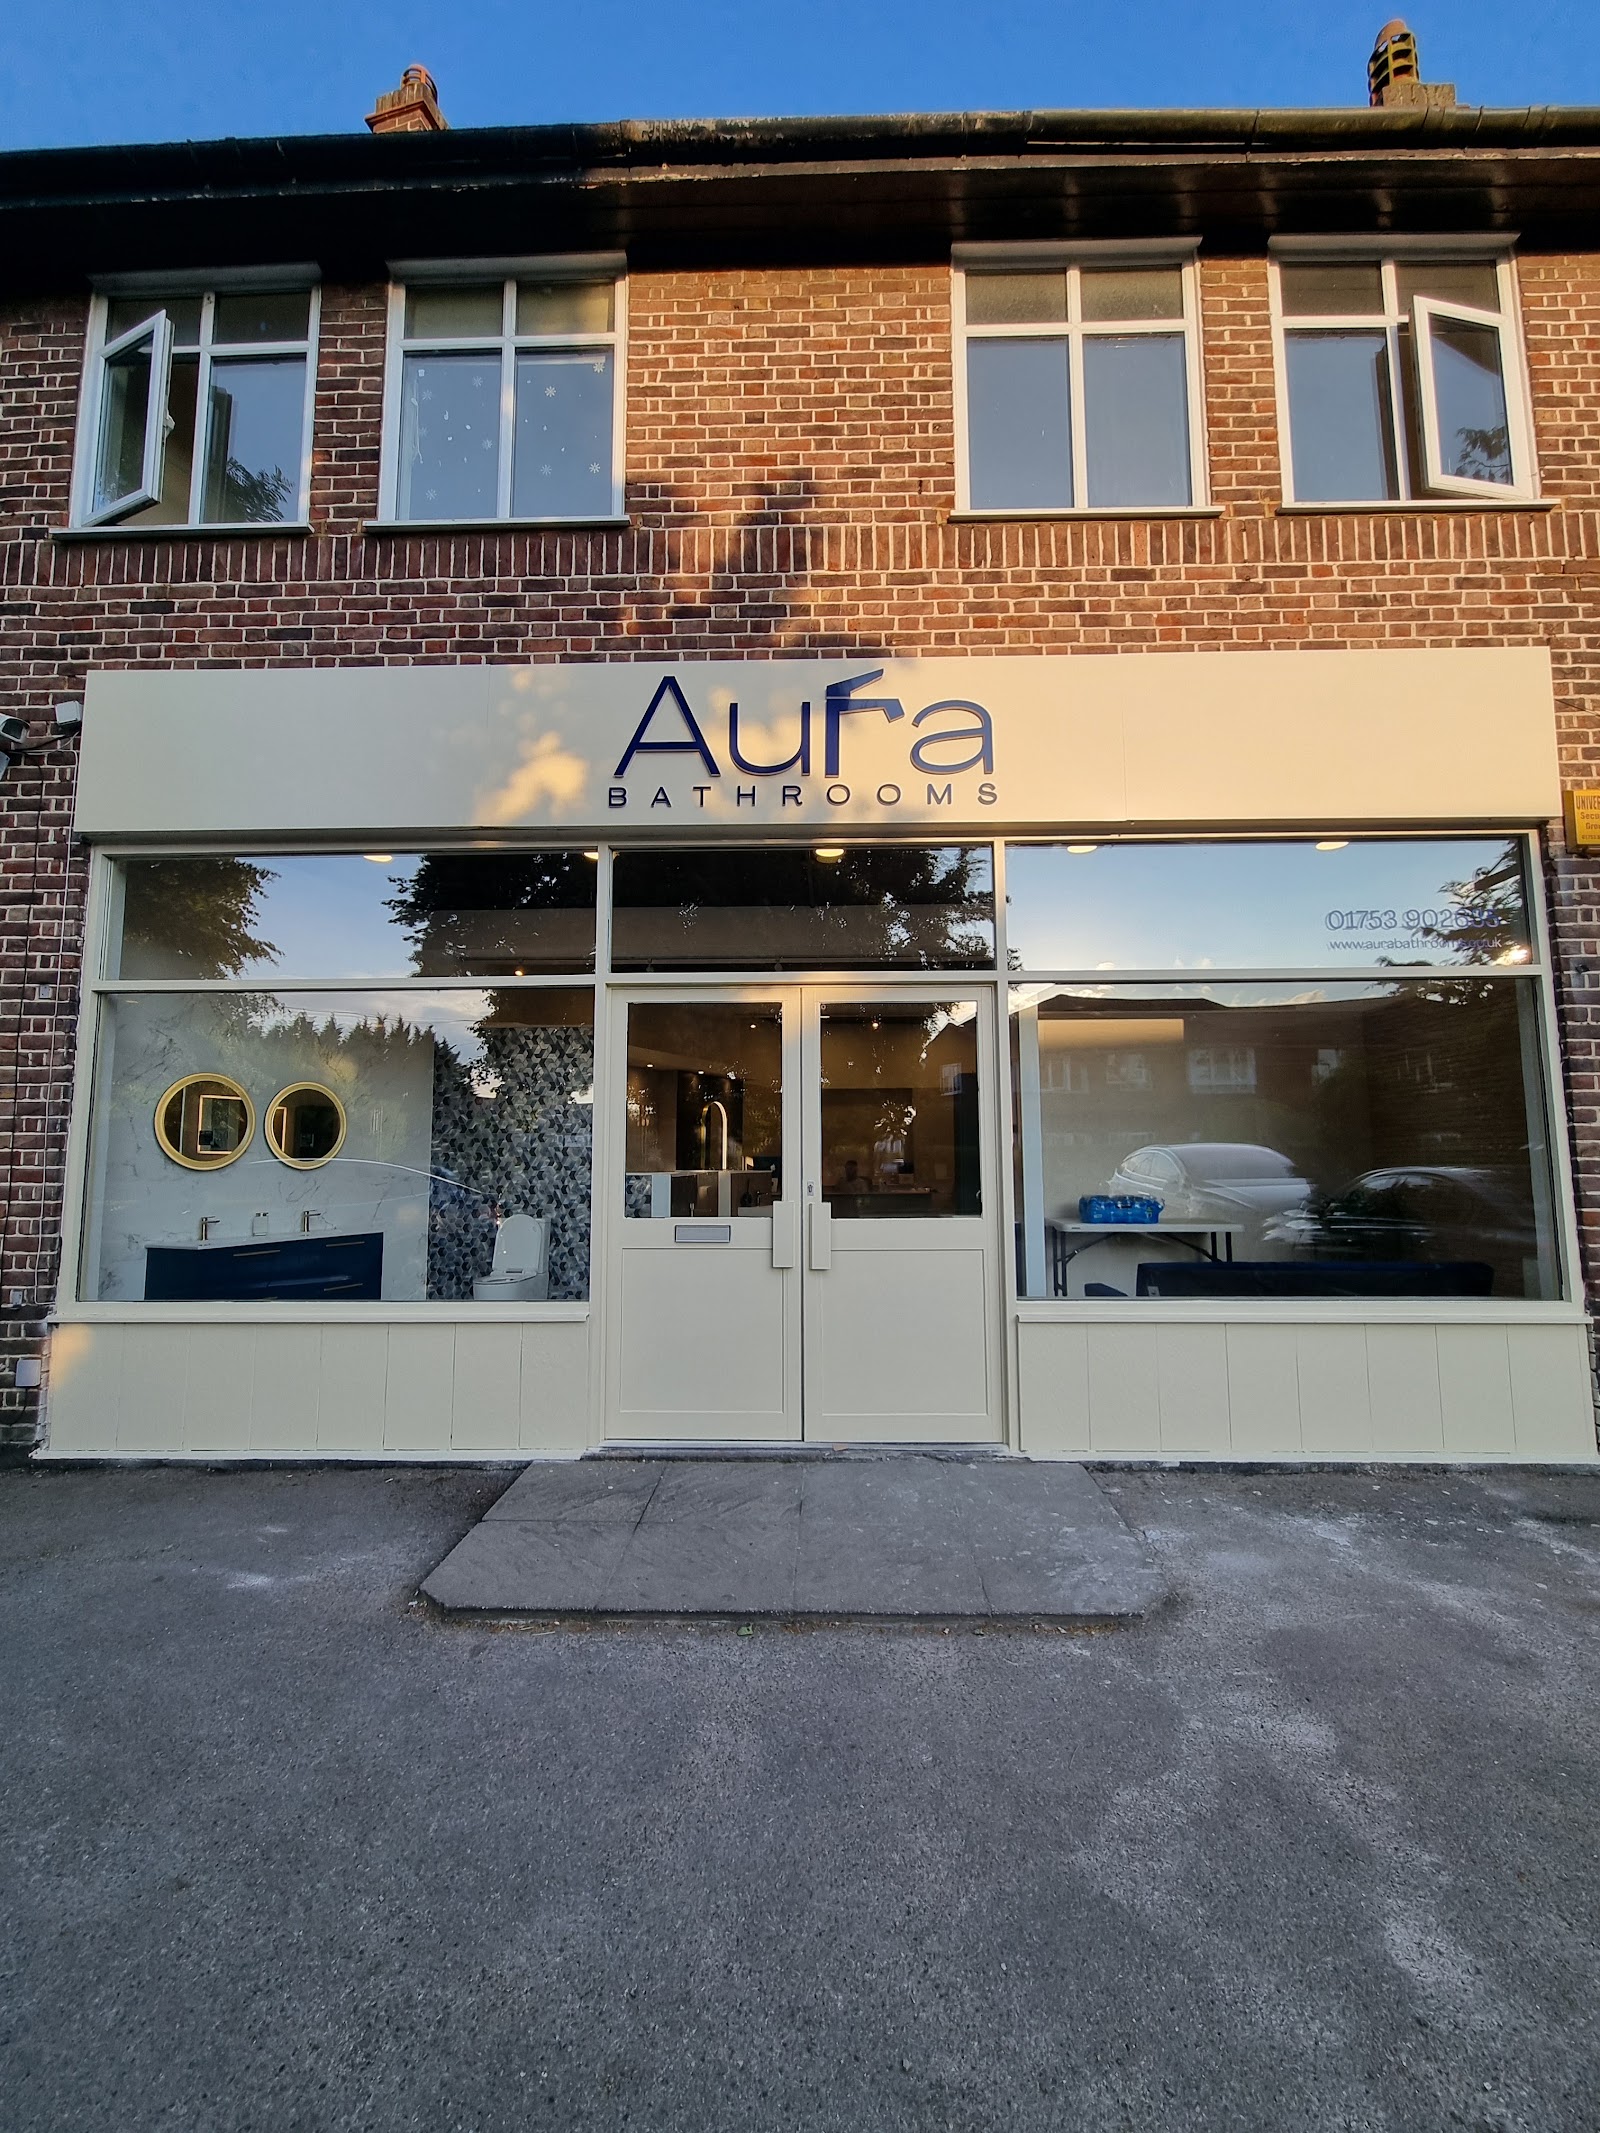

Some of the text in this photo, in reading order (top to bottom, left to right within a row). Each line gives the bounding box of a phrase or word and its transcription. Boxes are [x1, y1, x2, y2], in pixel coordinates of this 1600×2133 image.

[613, 668, 993, 778] Aura
[608, 783, 998, 809] BATHROOMS
[1327, 909, 1398, 930] 01753
[1329, 936, 1503, 950] www.aurabathrooms.co.uk
